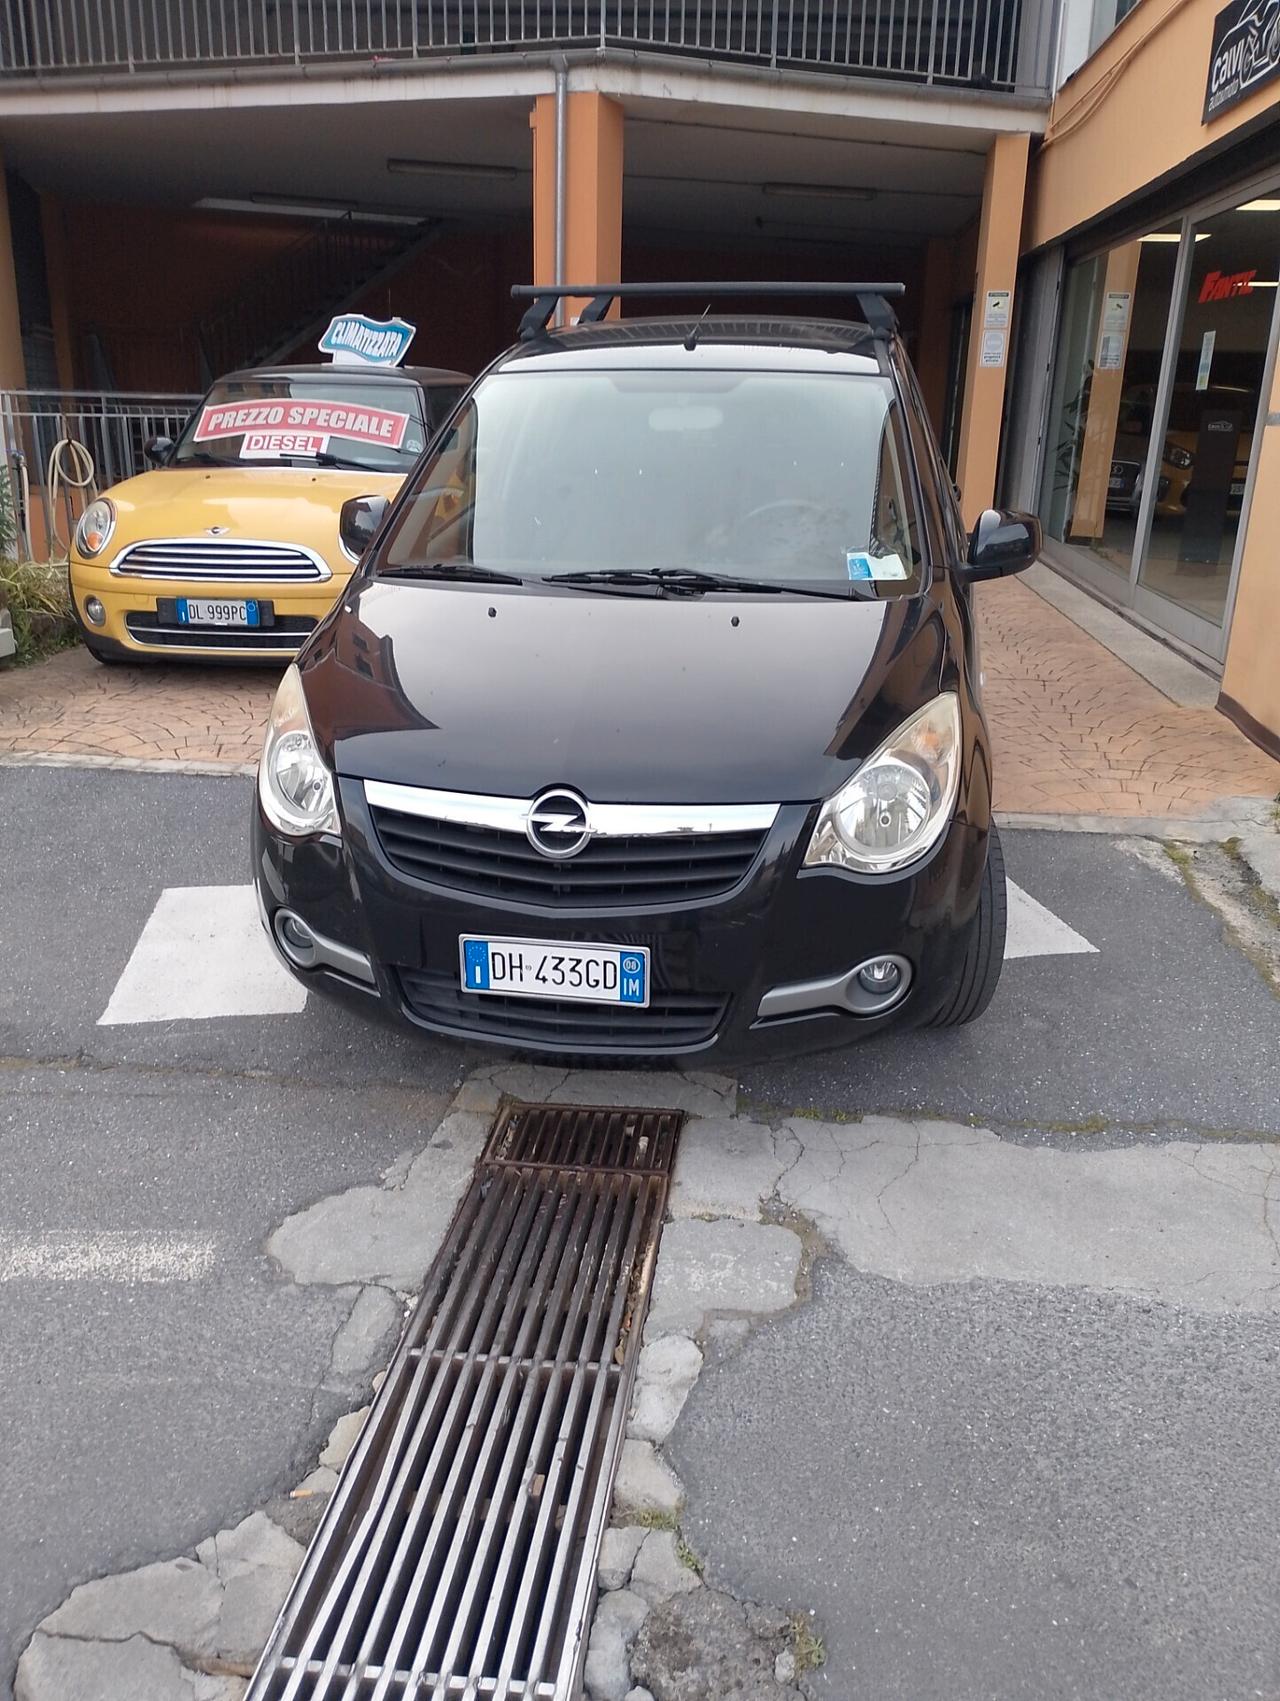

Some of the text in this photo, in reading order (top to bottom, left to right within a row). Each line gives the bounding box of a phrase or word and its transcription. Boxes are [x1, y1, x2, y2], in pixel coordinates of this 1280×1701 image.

[331, 320, 403, 358] CLIMATIZZATA
[207, 406, 394, 438] PREZZO SPECIALE
[249, 436, 319, 452] DIESEL
[188, 604, 247, 621] DL 999PC
[491, 952, 618, 990] DH 433GD
[623, 978, 640, 997] IM
